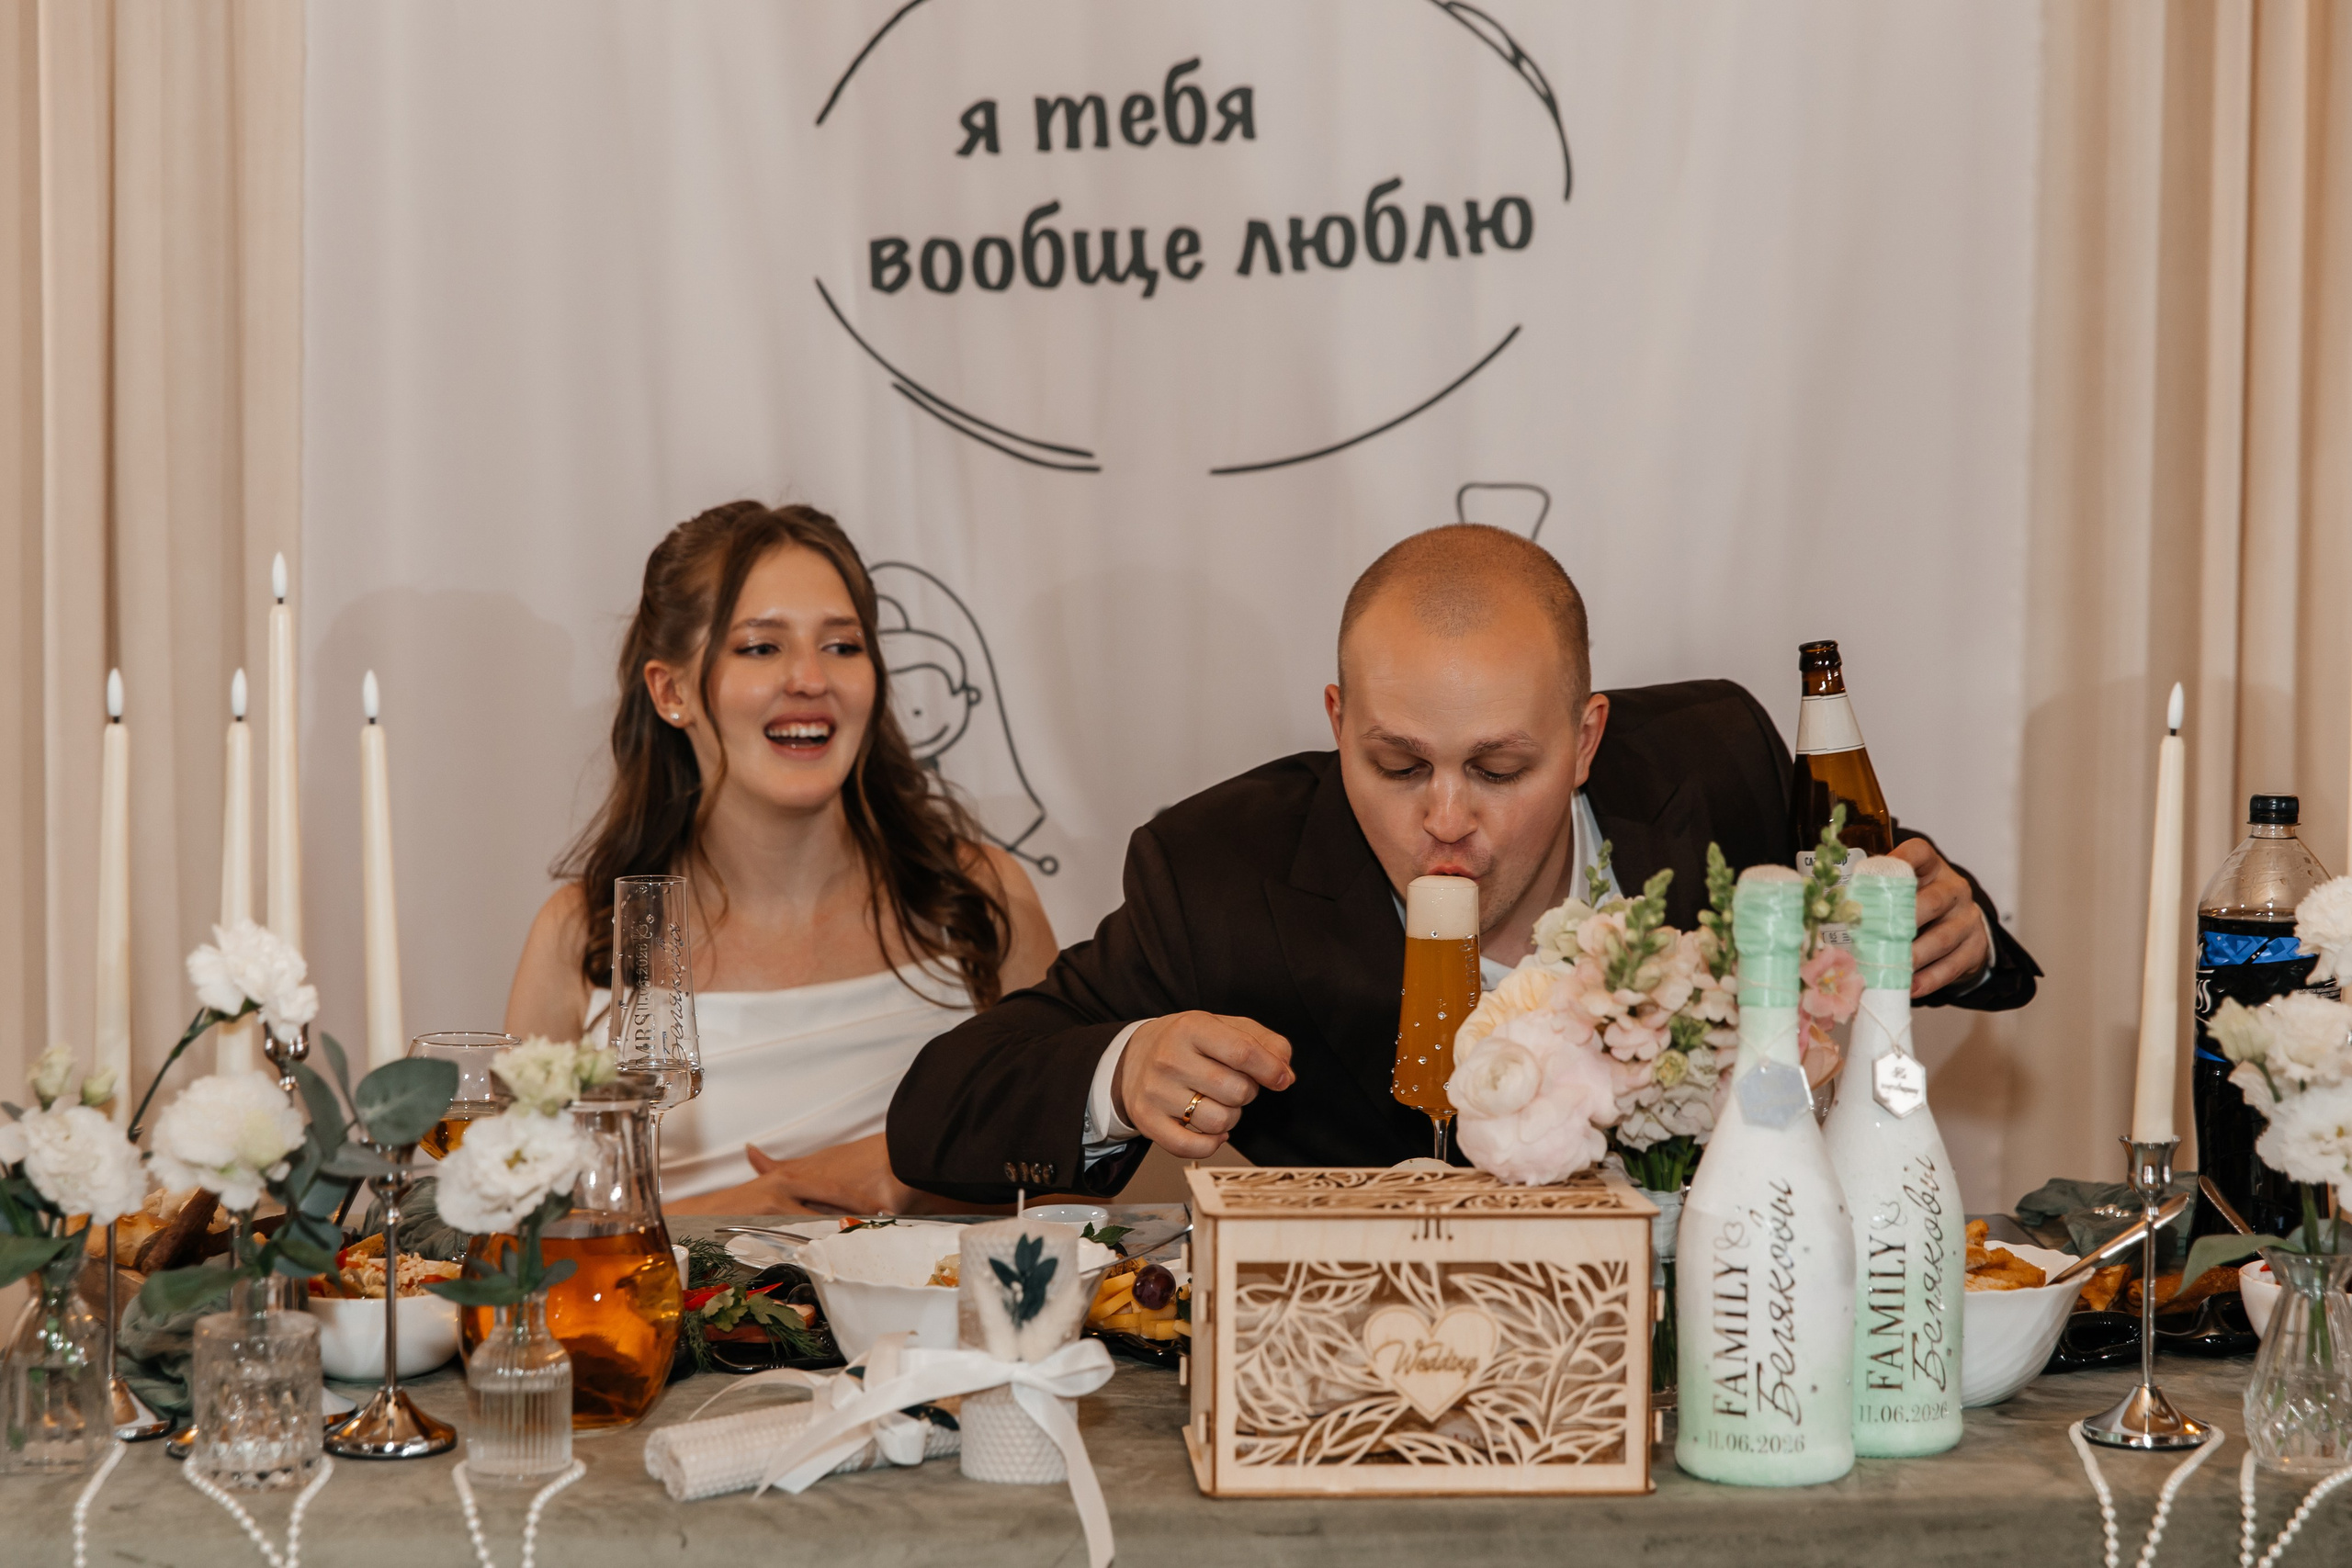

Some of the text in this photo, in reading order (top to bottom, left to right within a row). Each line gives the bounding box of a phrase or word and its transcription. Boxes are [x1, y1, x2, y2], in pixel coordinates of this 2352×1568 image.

[956, 57, 1256, 155] я тебя
[869, 176, 1534, 299] вообще люблю
[1713, 1255, 1748, 1418] FAMILY
[1866, 1235, 1905, 1392] FAMILY
[1708, 1430, 1805, 1453] 11.06.2026
[1859, 1401, 1949, 1423] 11.06.2026
